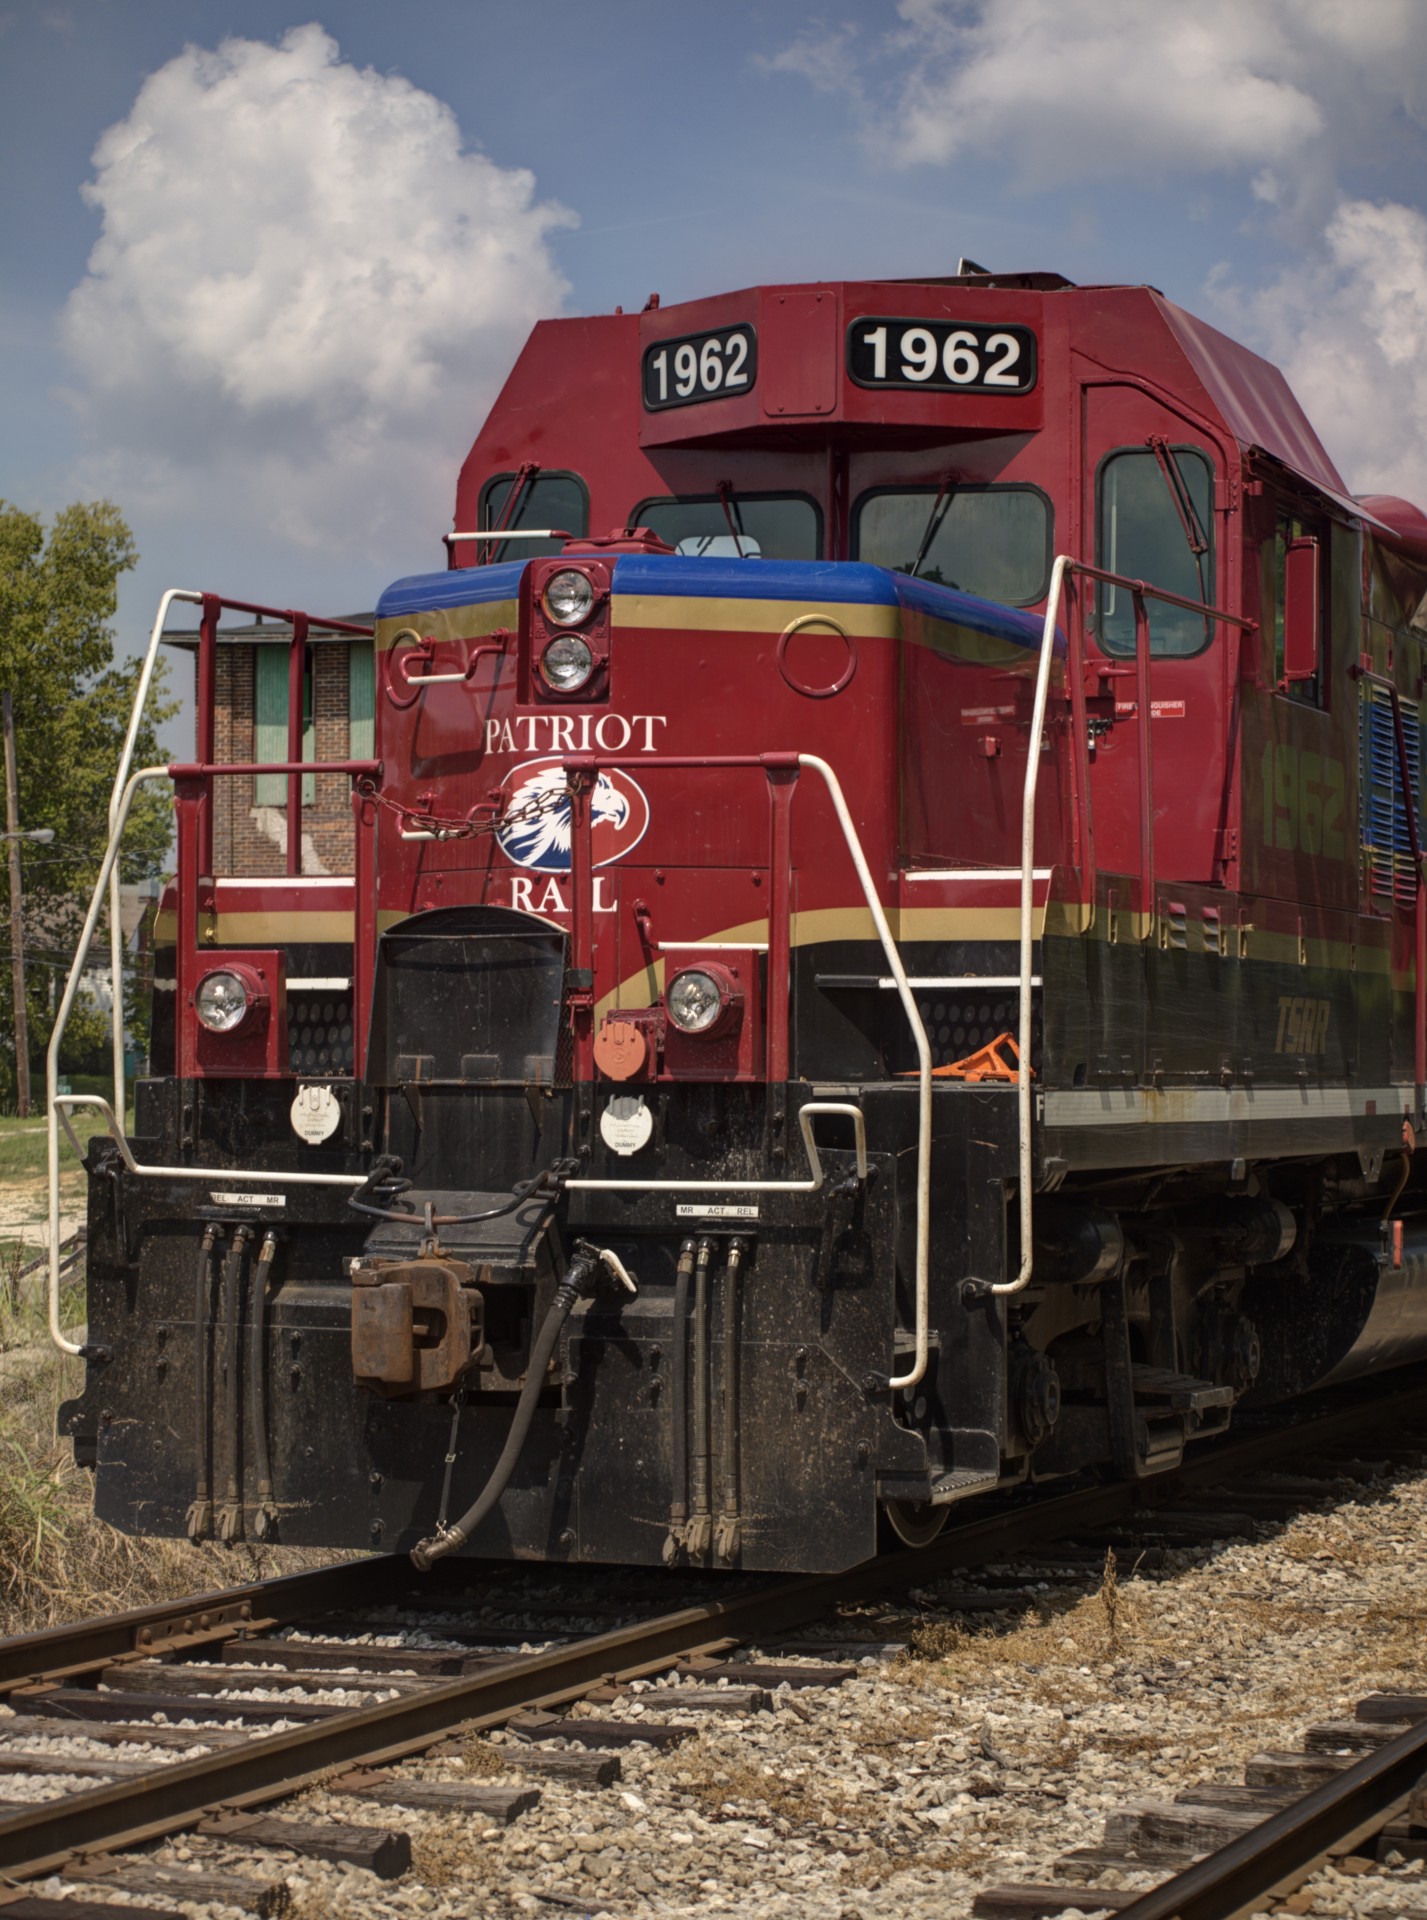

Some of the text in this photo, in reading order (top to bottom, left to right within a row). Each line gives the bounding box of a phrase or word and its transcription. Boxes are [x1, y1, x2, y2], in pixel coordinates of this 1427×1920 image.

[652, 333, 749, 400] 1962
[863, 326, 1020, 386] 1962
[484, 714, 667, 755] PATRIOT
[1262, 740, 1345, 860] 1962
[510, 876, 618, 913] RAL
[1274, 995, 1330, 1055] TSRR
[211, 1194, 279, 1204] REL ACT MR
[680, 1206, 754, 1216] MR ACT REL
